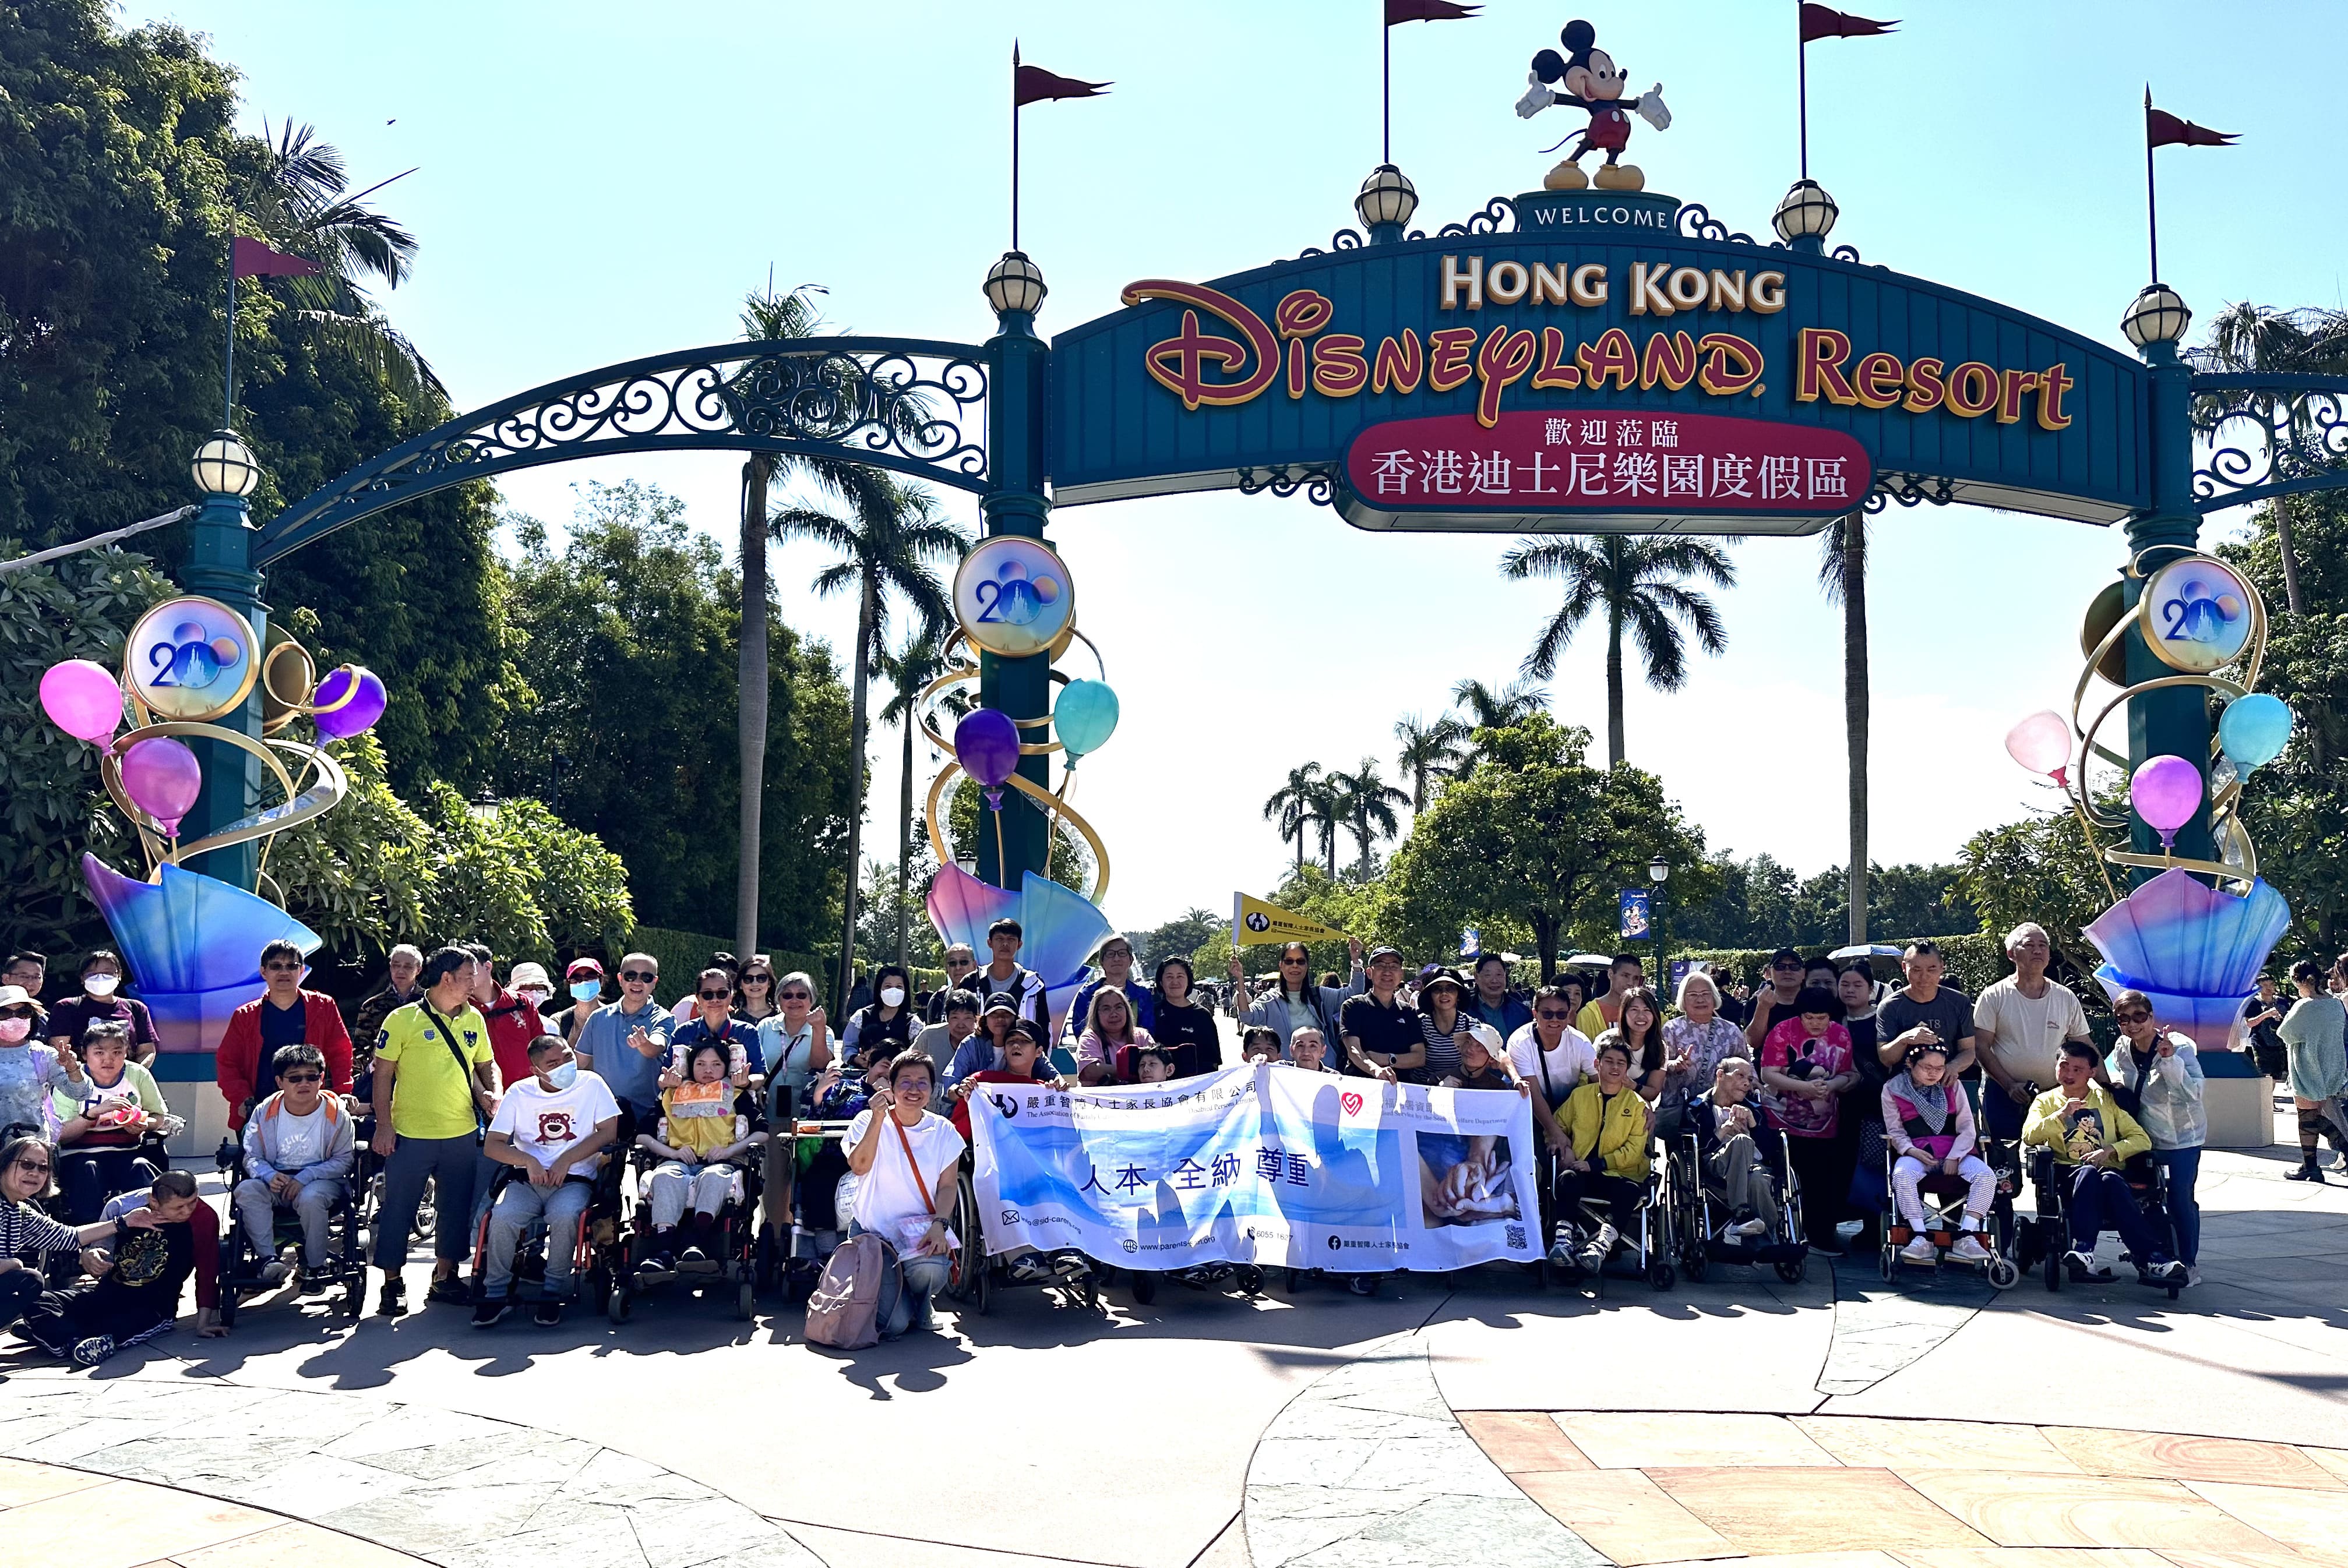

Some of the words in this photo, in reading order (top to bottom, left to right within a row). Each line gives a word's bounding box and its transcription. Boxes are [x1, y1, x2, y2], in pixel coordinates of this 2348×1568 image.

[1535, 207, 1667, 229] WELCOME
[1440, 254, 1608, 310] HONG
[1630, 262, 1786, 316] KONG
[1796, 327, 2074, 430] Resort
[1544, 418, 1679, 448] 歡迎蒞臨
[1370, 449, 1850, 500] 香港迪士尼樂園度假區
[1080, 1163, 1149, 1196] 人本
[1172, 1152, 1241, 1190] 全納
[1256, 1146, 1310, 1188] 尊重
[1140, 1235, 1215, 1251] www.parents-.org
[1256, 1230, 1274, 1238] 6055
